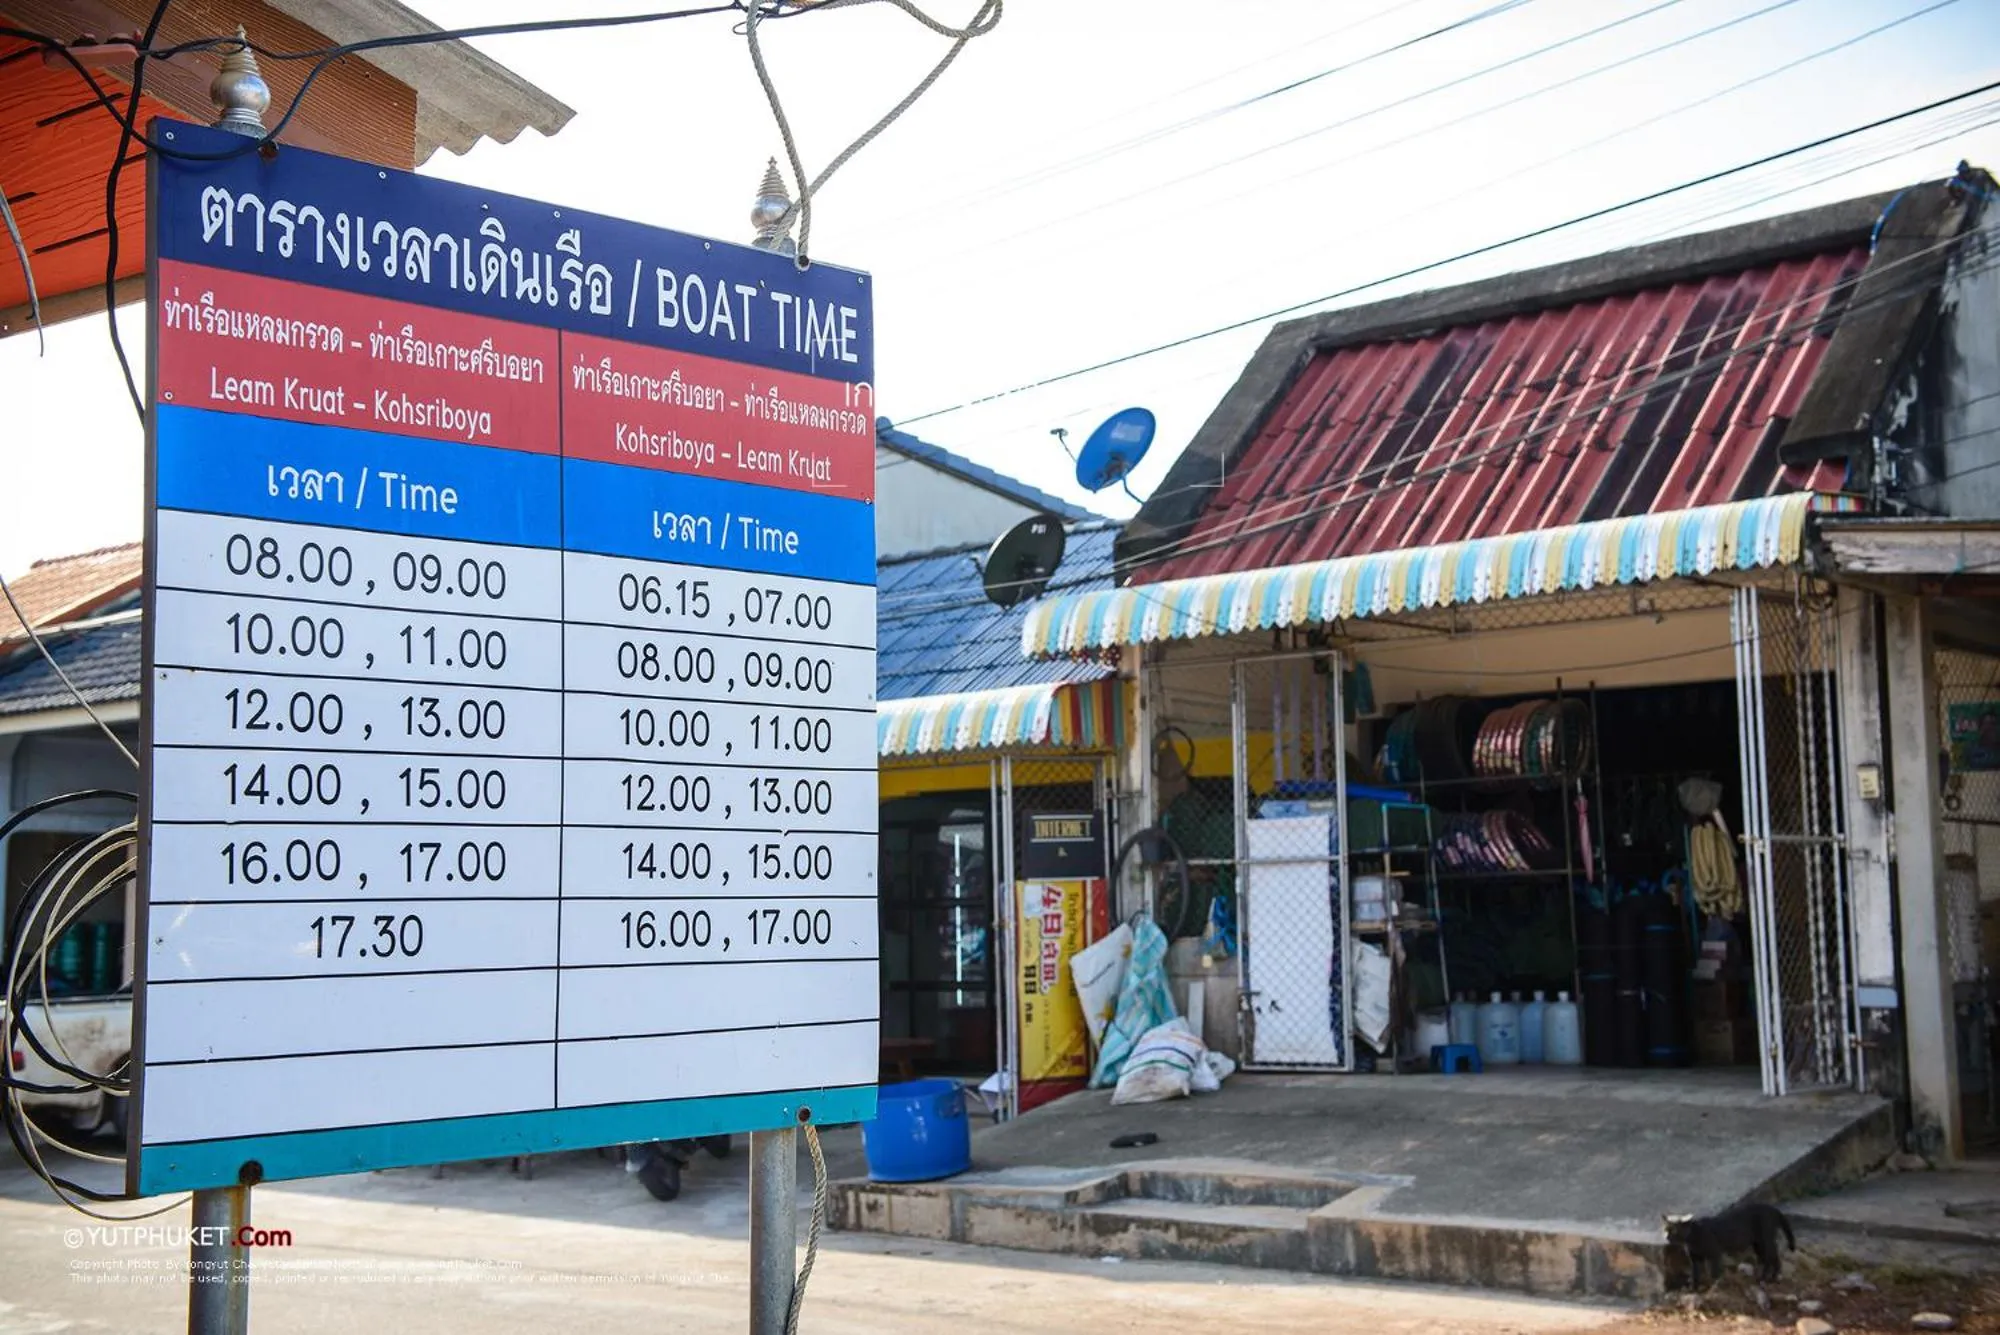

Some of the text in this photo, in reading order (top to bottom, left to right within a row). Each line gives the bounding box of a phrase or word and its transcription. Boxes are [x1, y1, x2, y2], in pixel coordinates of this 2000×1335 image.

[201, 185, 858, 363] ตารางเวลาเดินเรือ / BOAT TIME
[164, 286, 344, 353] ท่าเรือแหลมกรวด
[369, 321, 544, 384] ท่าเรือเกาะศรีบอยา
[210, 366, 275, 408] Leam
[284, 377, 345, 417] Kruat
[374, 390, 492, 440] Kohsriboya
[572, 354, 725, 413] ท่าเรือเกาะศรีบอยา
[744, 383, 867, 436] ท่าเรือแหลมกรวด
[268, 463, 344, 503] เวลา
[379, 471, 459, 515] Time
[615, 423, 715, 471] Kohsriboya
[737, 441, 783, 474] Leam
[788, 449, 832, 482] Kruat
[652, 510, 712, 544] เวลา
[738, 516, 799, 555] Time
